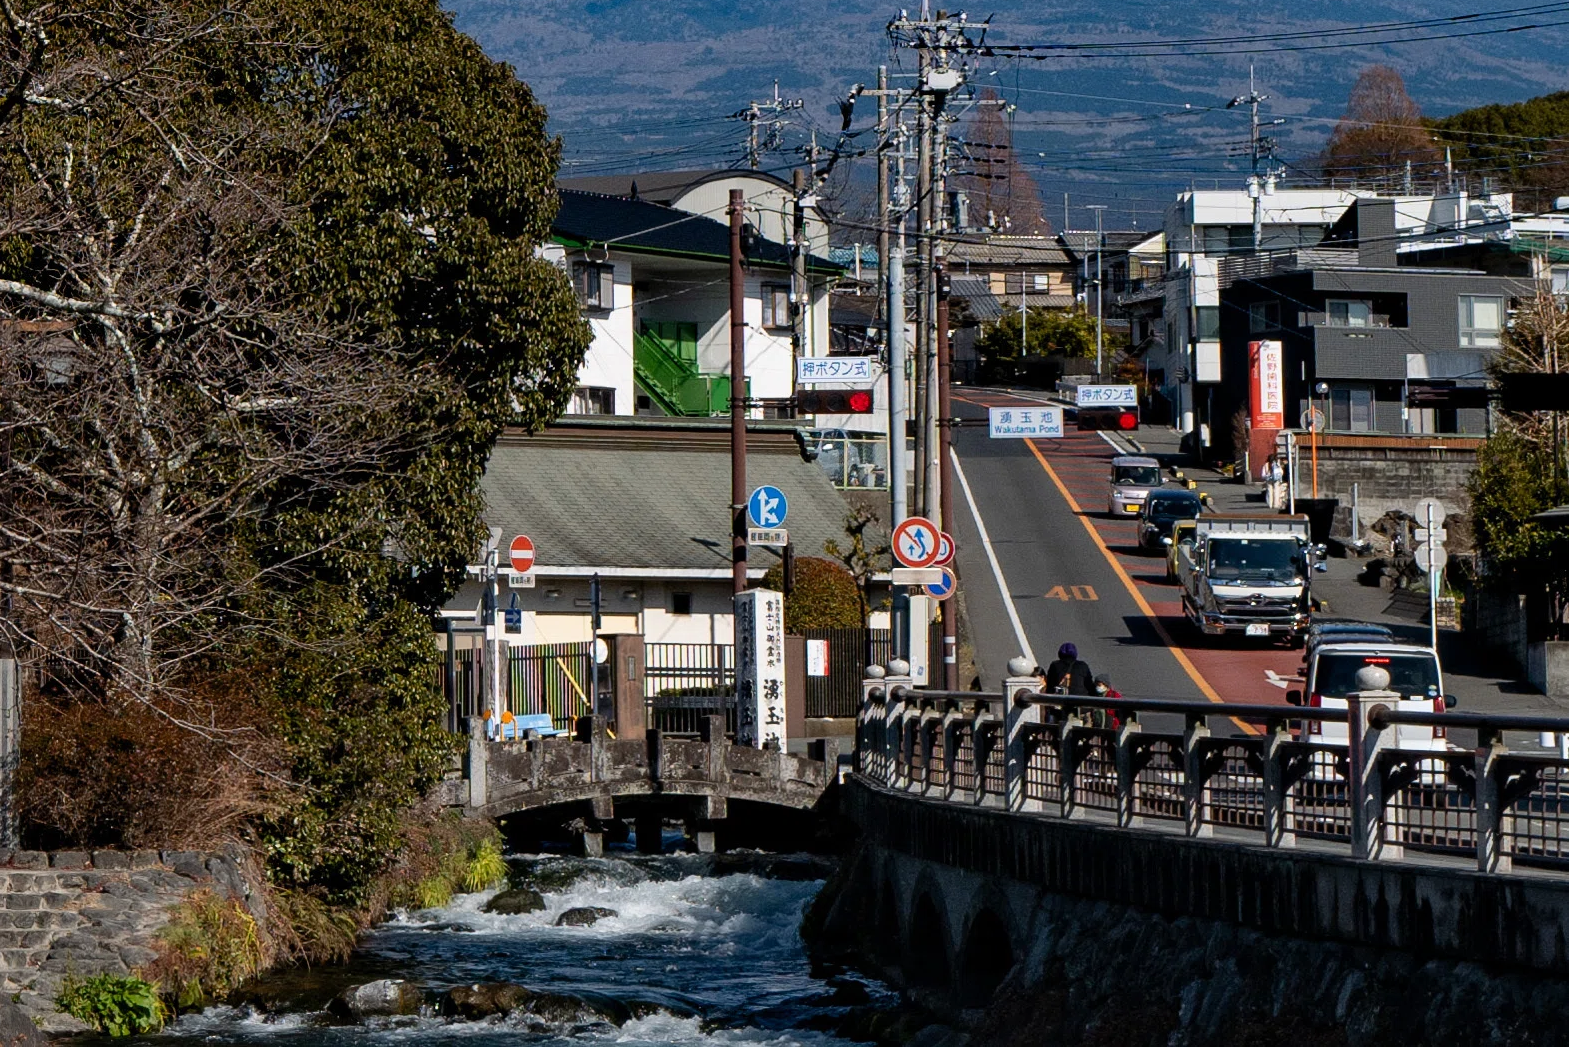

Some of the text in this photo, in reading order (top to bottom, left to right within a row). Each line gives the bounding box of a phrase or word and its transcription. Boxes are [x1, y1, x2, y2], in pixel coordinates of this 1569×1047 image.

[803, 361, 867, 377] 押ボタン式
[1081, 388, 1134, 401] 押ボタン式
[994, 424, 1060, 434] Wakutama Pond
[1044, 585, 1099, 601] 40
